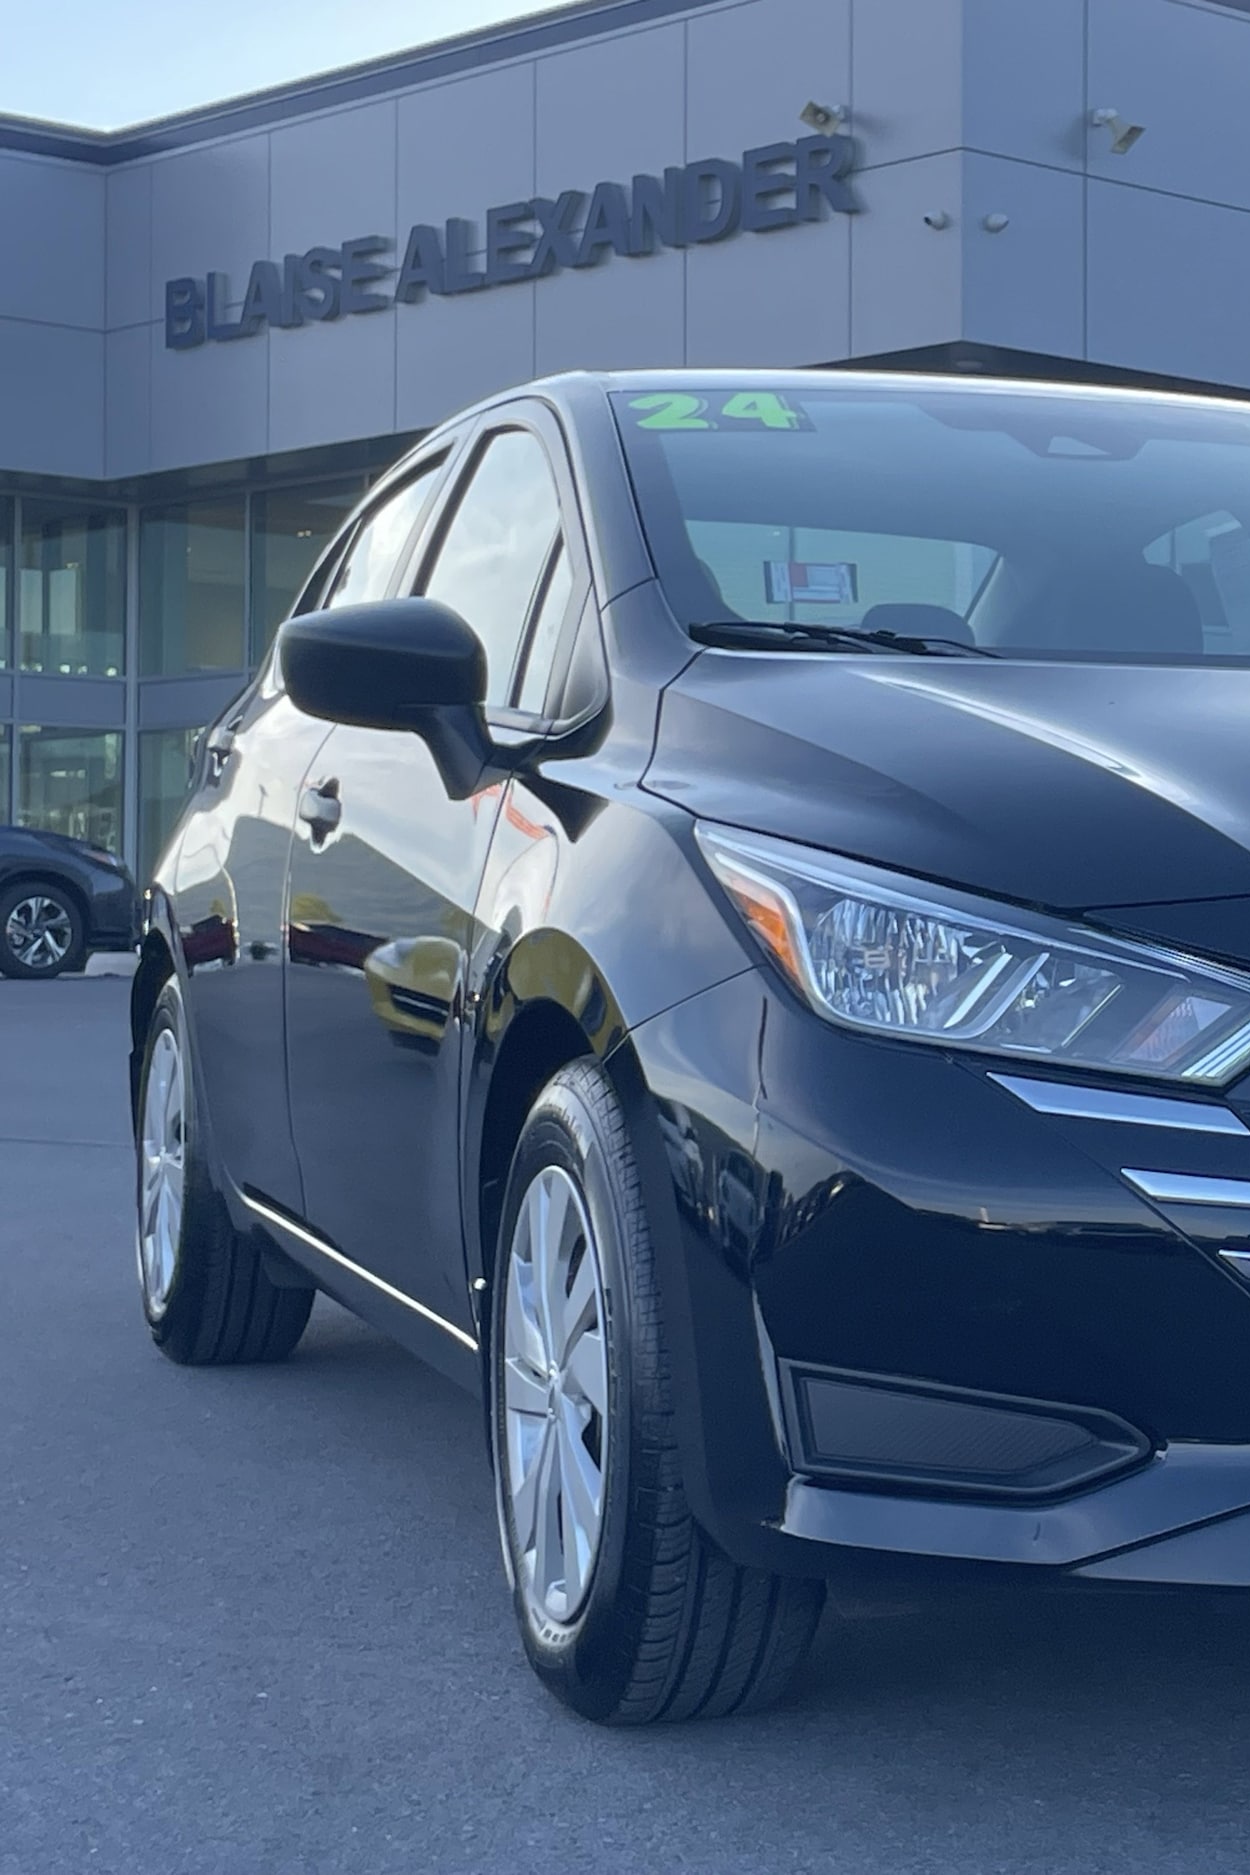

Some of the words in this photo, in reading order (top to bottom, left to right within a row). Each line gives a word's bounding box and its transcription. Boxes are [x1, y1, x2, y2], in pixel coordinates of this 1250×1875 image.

[165, 235, 393, 349] BLAISE
[395, 134, 860, 303] ALEXANDER
[628, 392, 797, 430] 24
